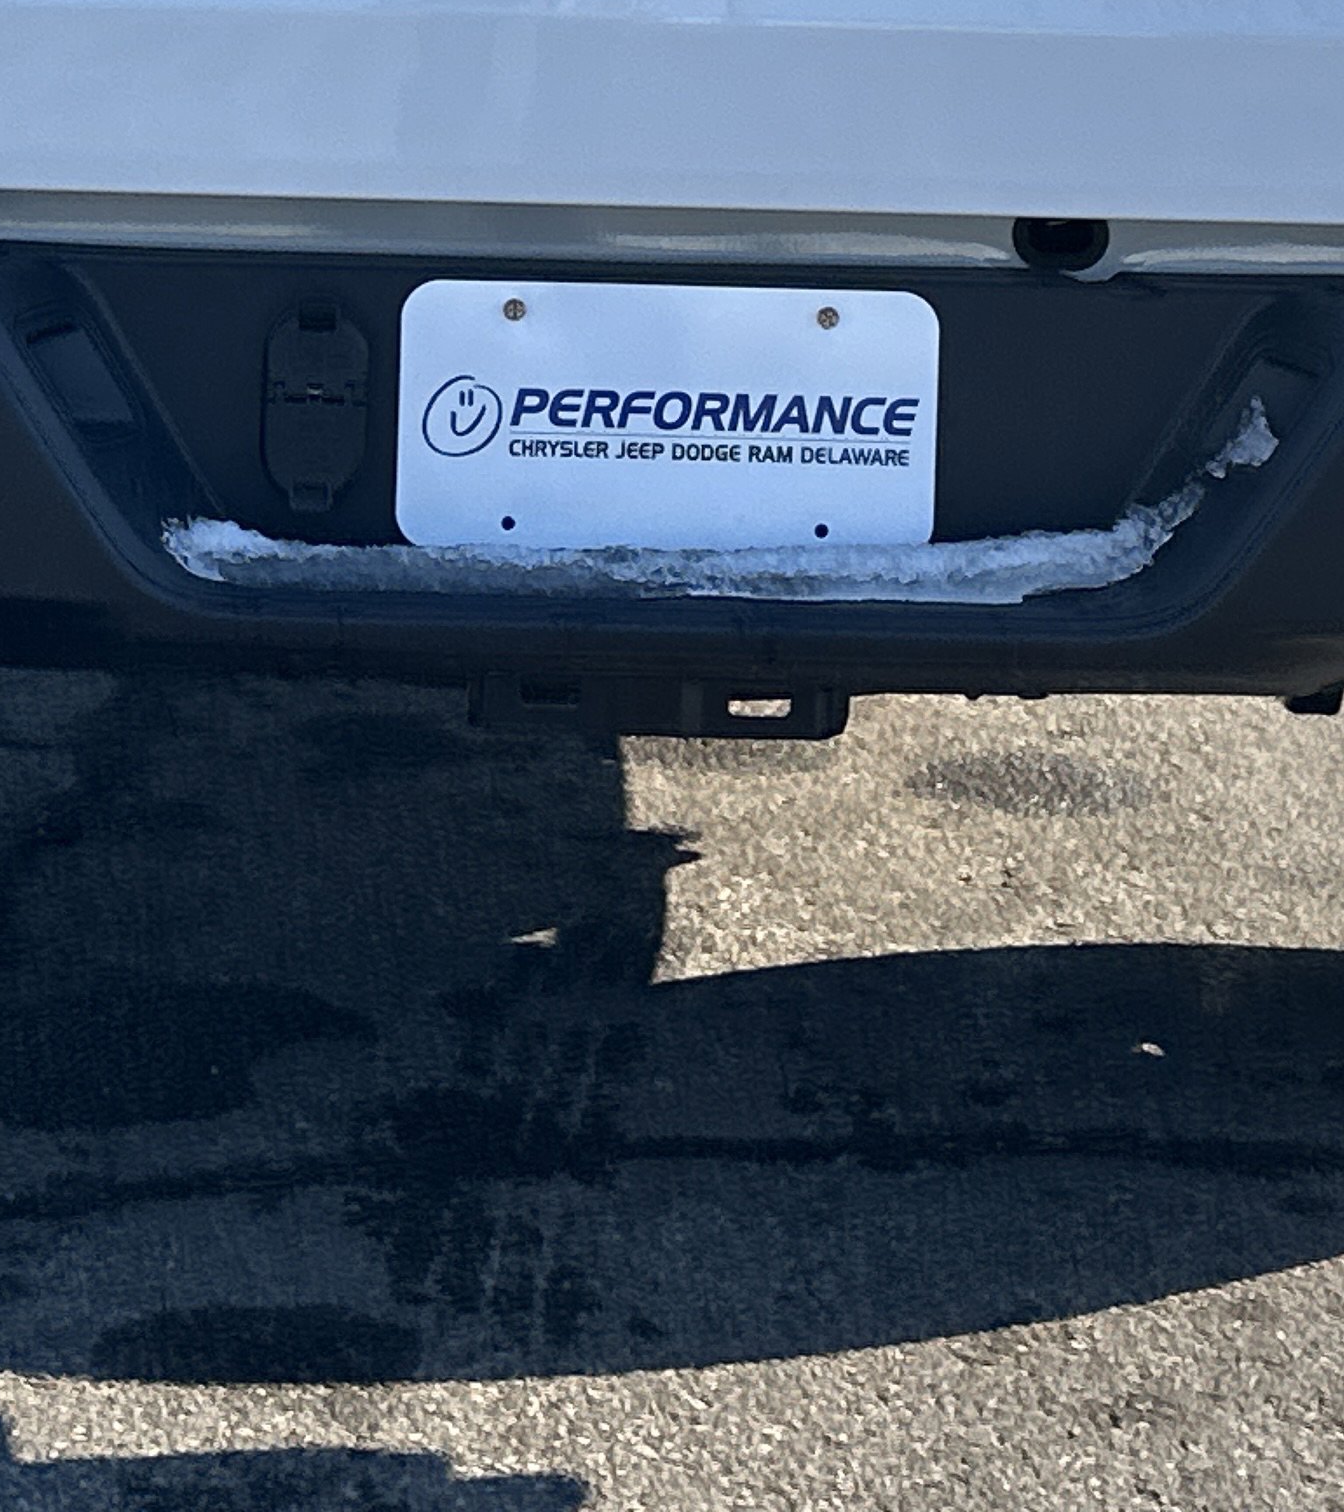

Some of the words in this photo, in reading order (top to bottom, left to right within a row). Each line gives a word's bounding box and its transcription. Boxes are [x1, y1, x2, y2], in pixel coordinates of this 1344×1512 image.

[509, 388, 920, 437] PERFORMANCE
[509, 439, 609, 460] CHRYSLER
[615, 441, 664, 461] JEEP
[672, 443, 741, 463] DODGE
[748, 445, 793, 464] RAM
[801, 446, 910, 467] DELAWARE
